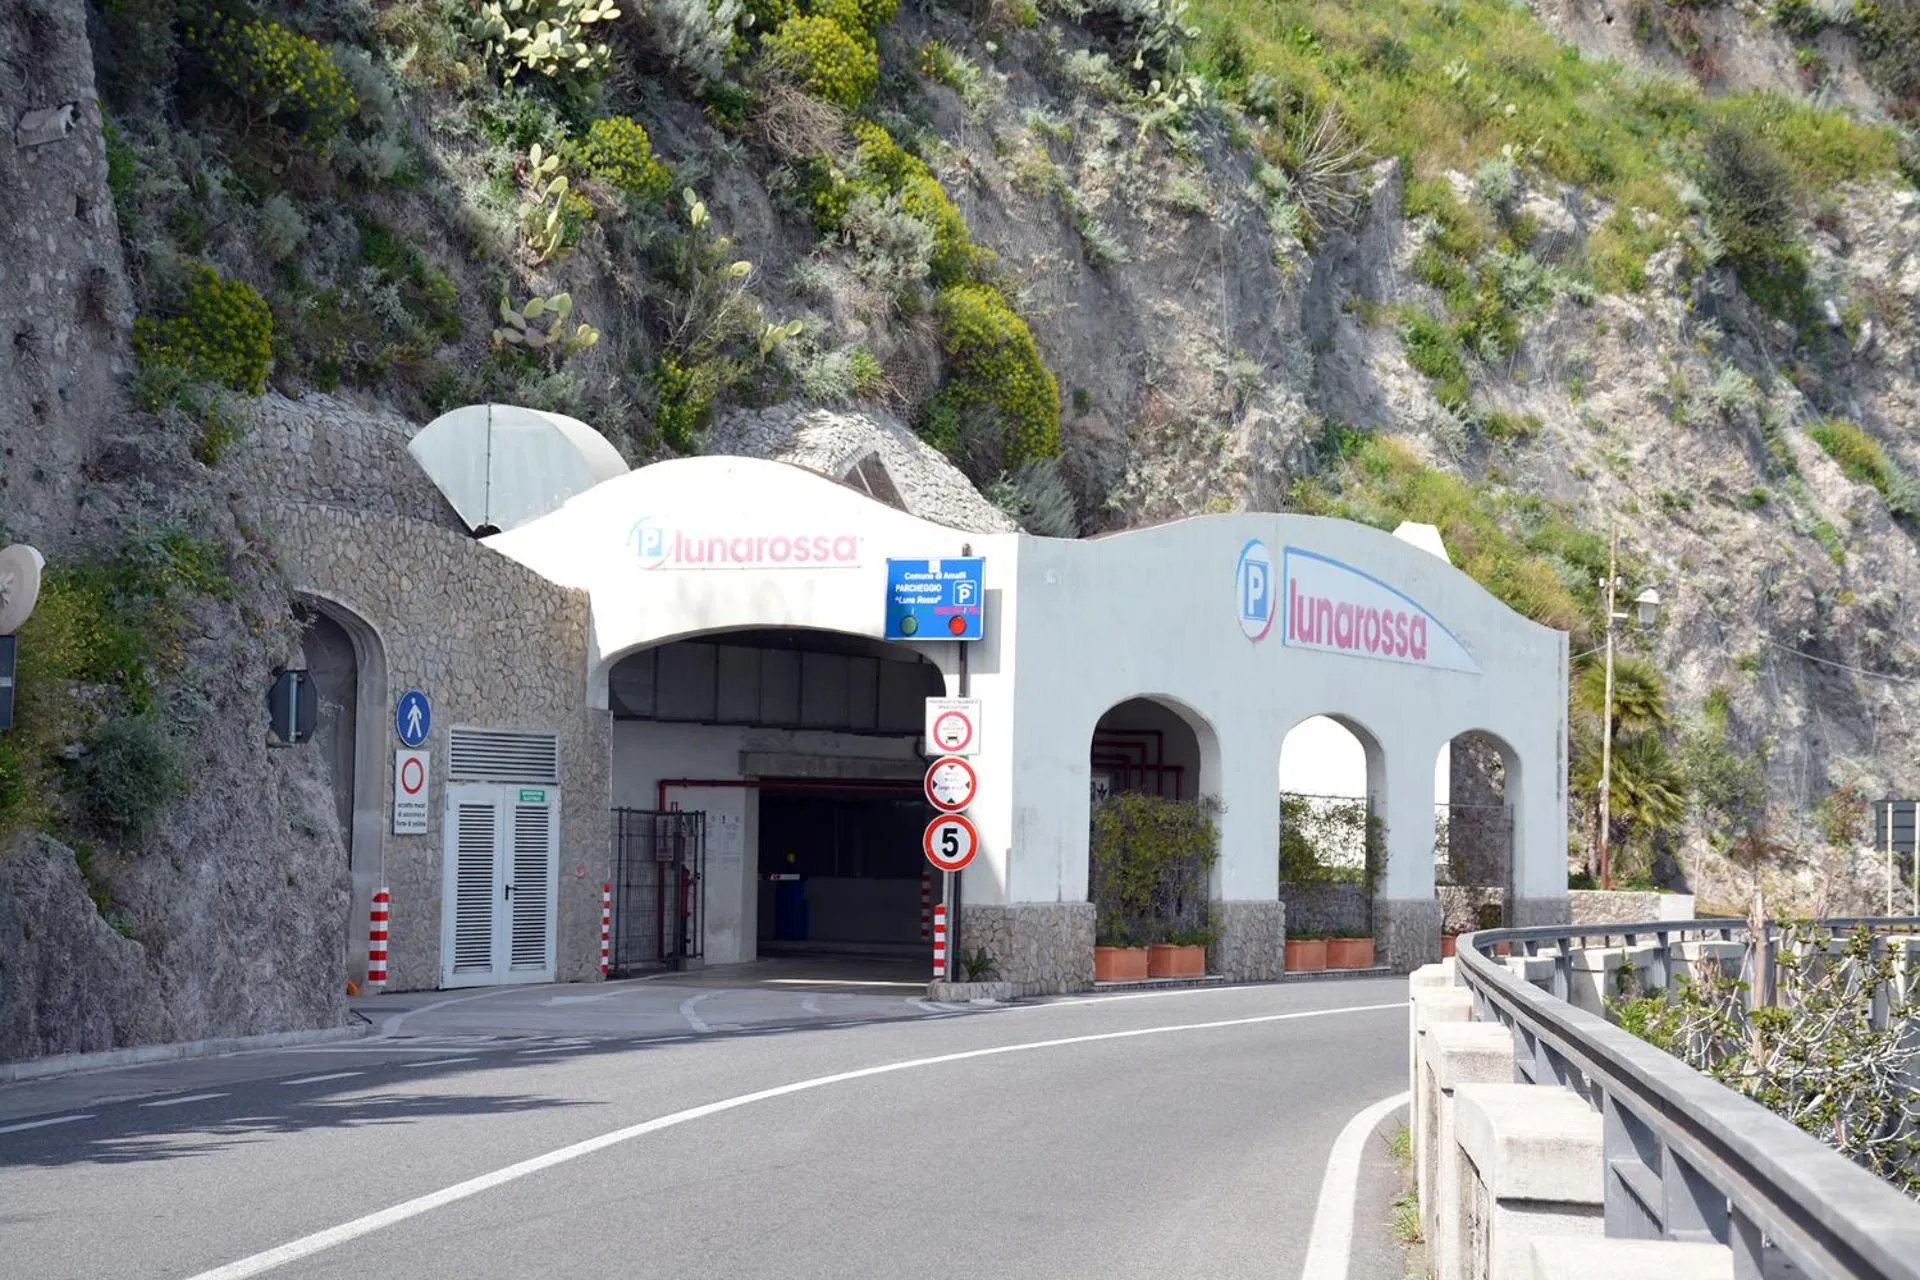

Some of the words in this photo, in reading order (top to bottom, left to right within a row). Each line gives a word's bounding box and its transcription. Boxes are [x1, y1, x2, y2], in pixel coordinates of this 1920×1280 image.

[675, 531, 857, 563] lunarossa
[895, 584, 942, 592] PARCHEGGIO
[959, 589, 971, 604] P
[1247, 564, 1265, 615] P
[1289, 578, 1427, 660] lunarossa
[942, 828, 959, 858] 5
